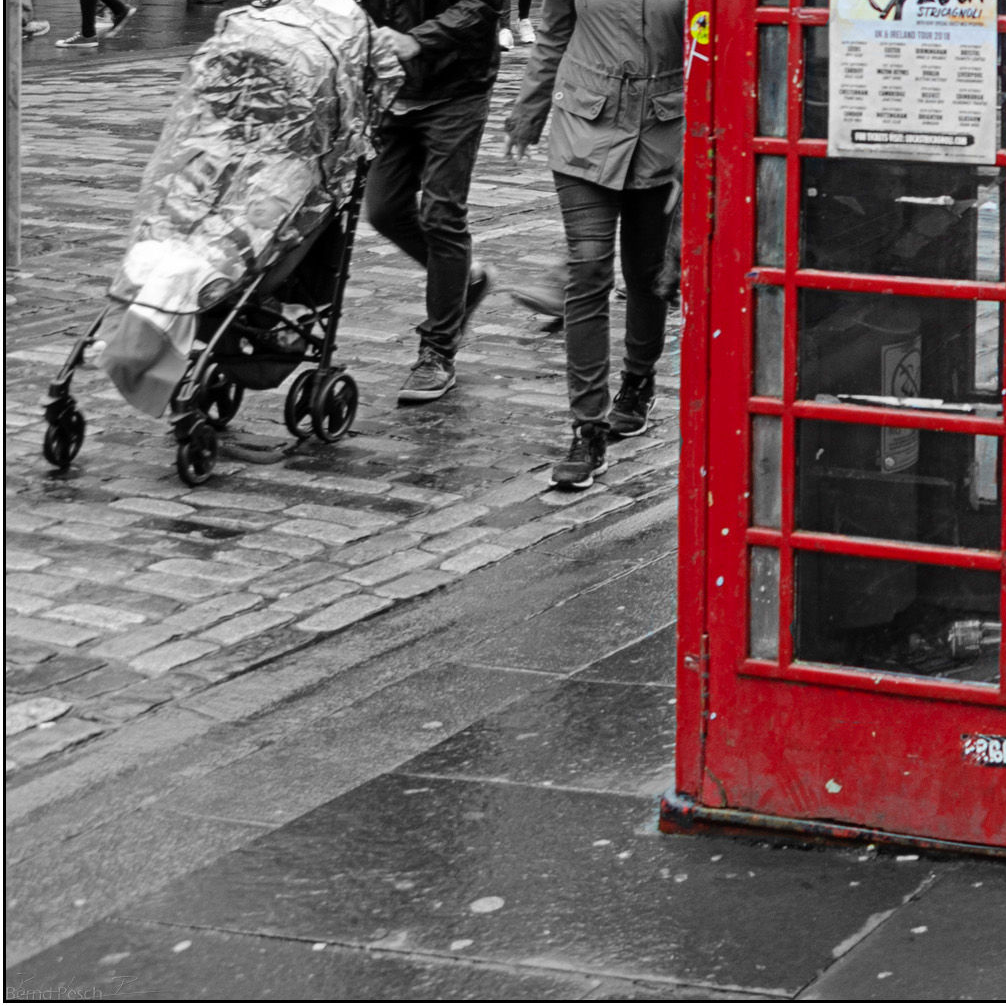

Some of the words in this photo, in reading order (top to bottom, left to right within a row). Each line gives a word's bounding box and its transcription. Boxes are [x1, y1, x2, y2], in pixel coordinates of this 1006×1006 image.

[917, 6, 983, 18] STRICAGNOLI
[890, 30, 915, 39] IRELAND
[918, 31, 933, 40] TOUR
